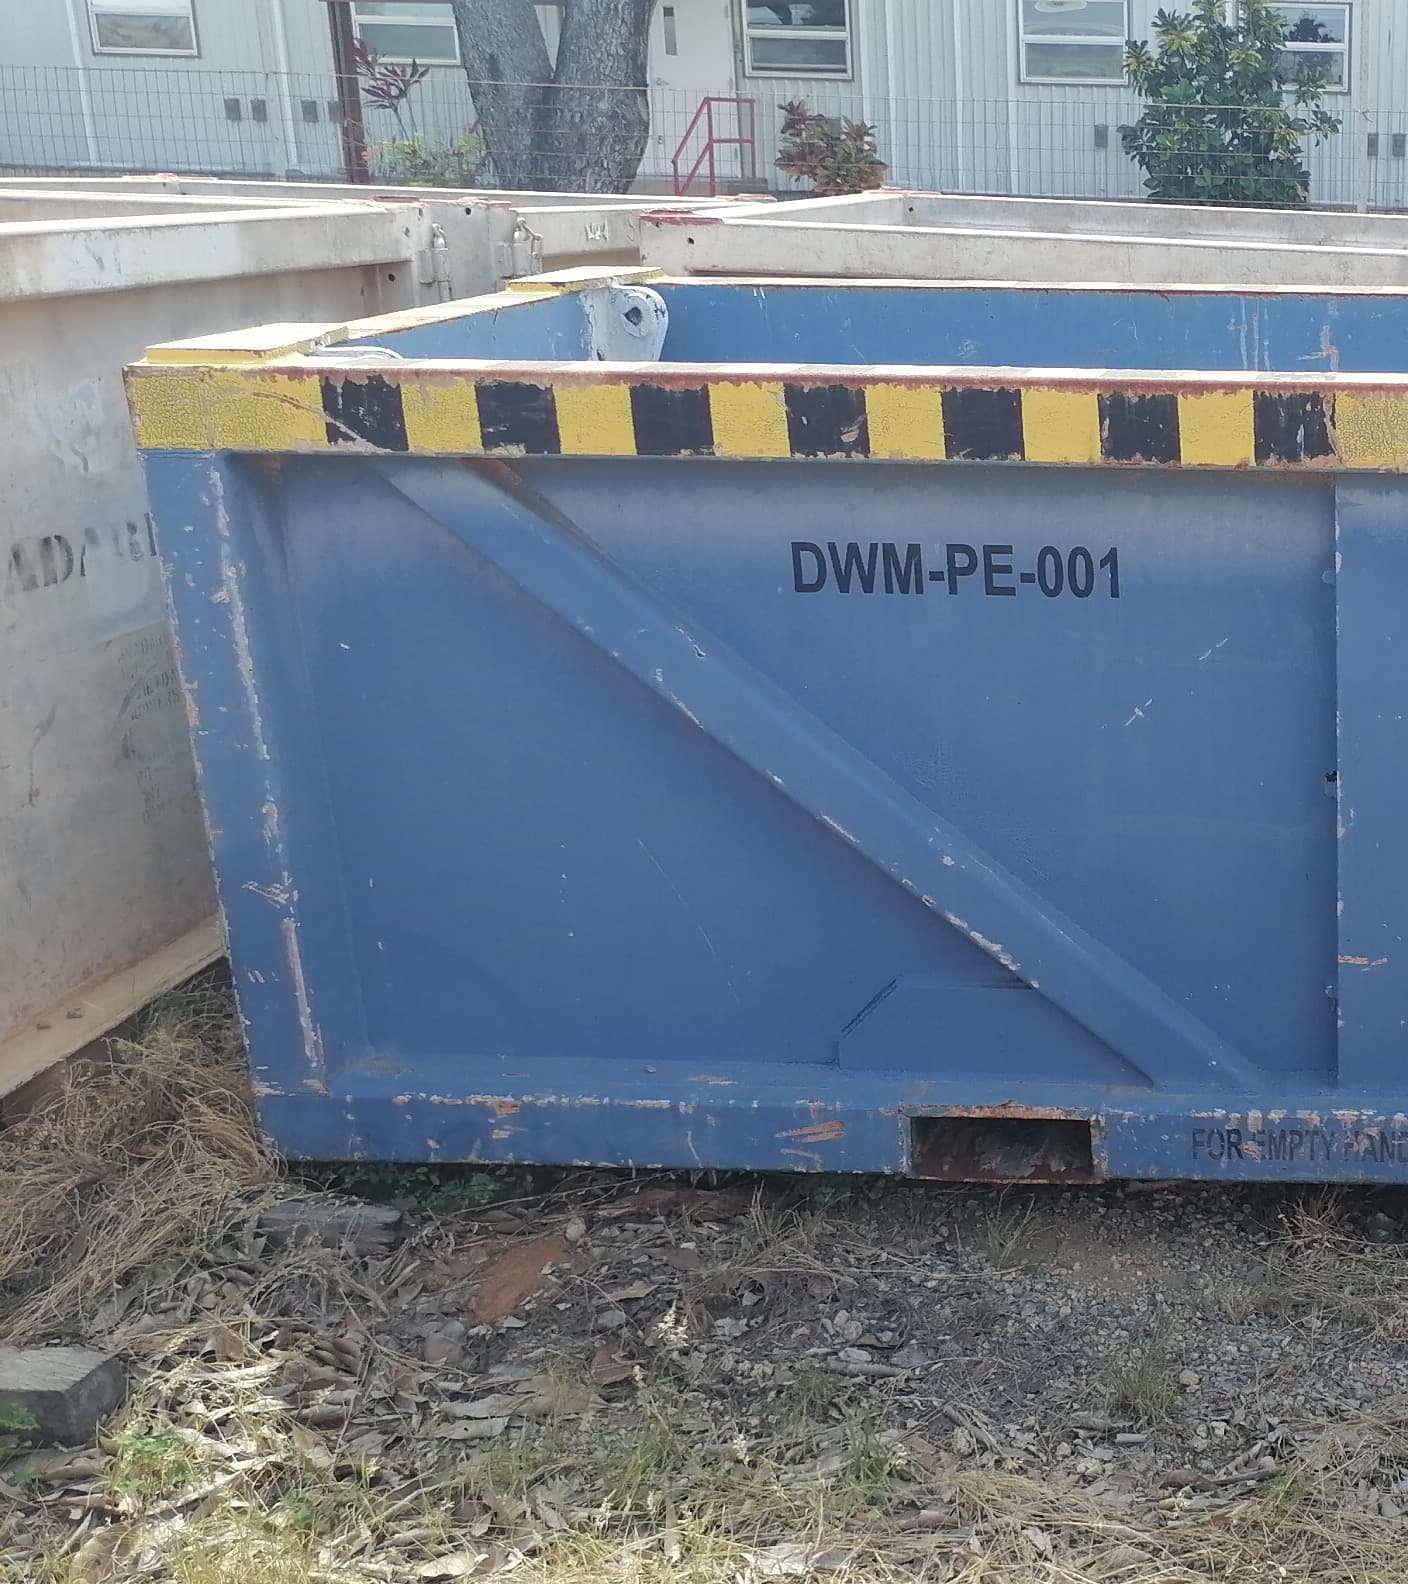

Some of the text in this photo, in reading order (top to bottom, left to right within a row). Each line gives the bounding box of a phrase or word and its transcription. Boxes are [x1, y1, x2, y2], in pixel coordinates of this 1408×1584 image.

[791, 541, 1120, 599] DWM-PE-001
[1192, 1128, 1244, 1161] FOR
[1248, 1129, 1335, 1161] EMPTY
